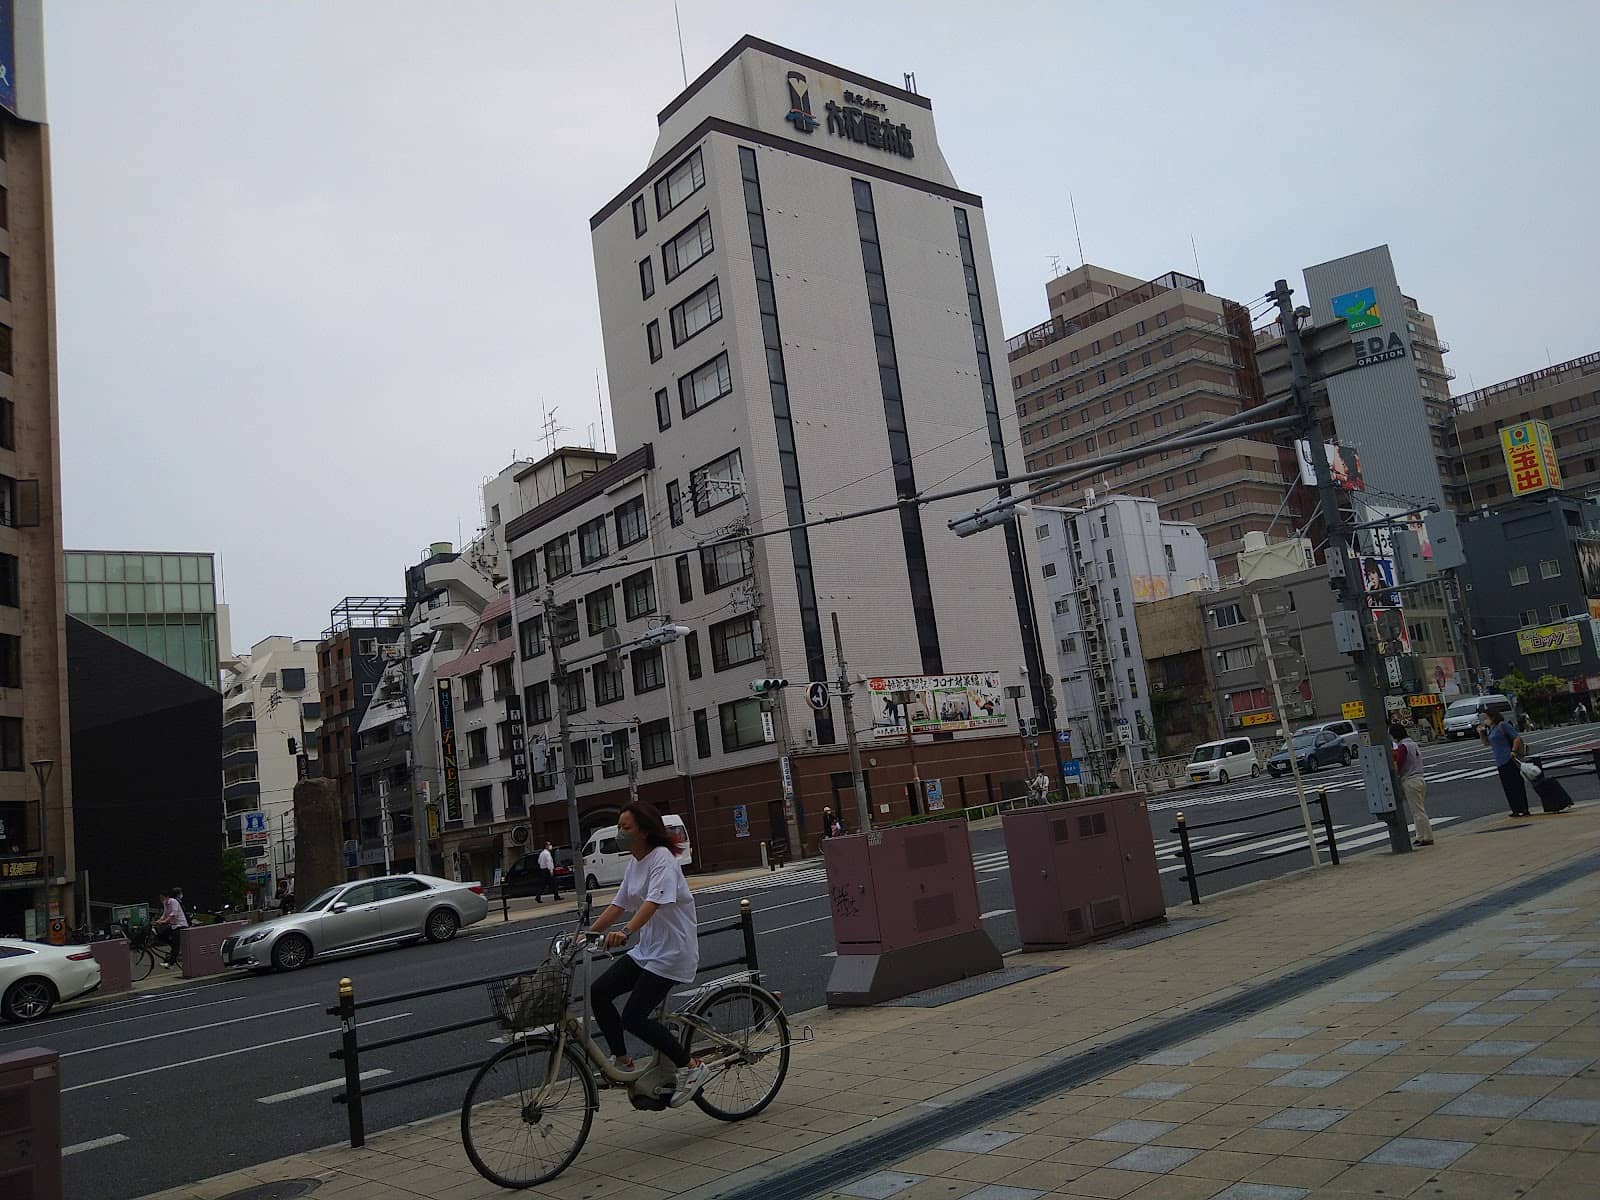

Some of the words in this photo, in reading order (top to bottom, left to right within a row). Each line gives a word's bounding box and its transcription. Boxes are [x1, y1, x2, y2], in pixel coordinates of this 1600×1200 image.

[1354, 332, 1403, 357] EDA
[1358, 349, 1404, 366] ORATION
[1509, 443, 1536, 454] スーパー
[1512, 450, 1542, 491] 玉出
[441, 692, 451, 728] HOTEL
[443, 728, 457, 780] FINE
